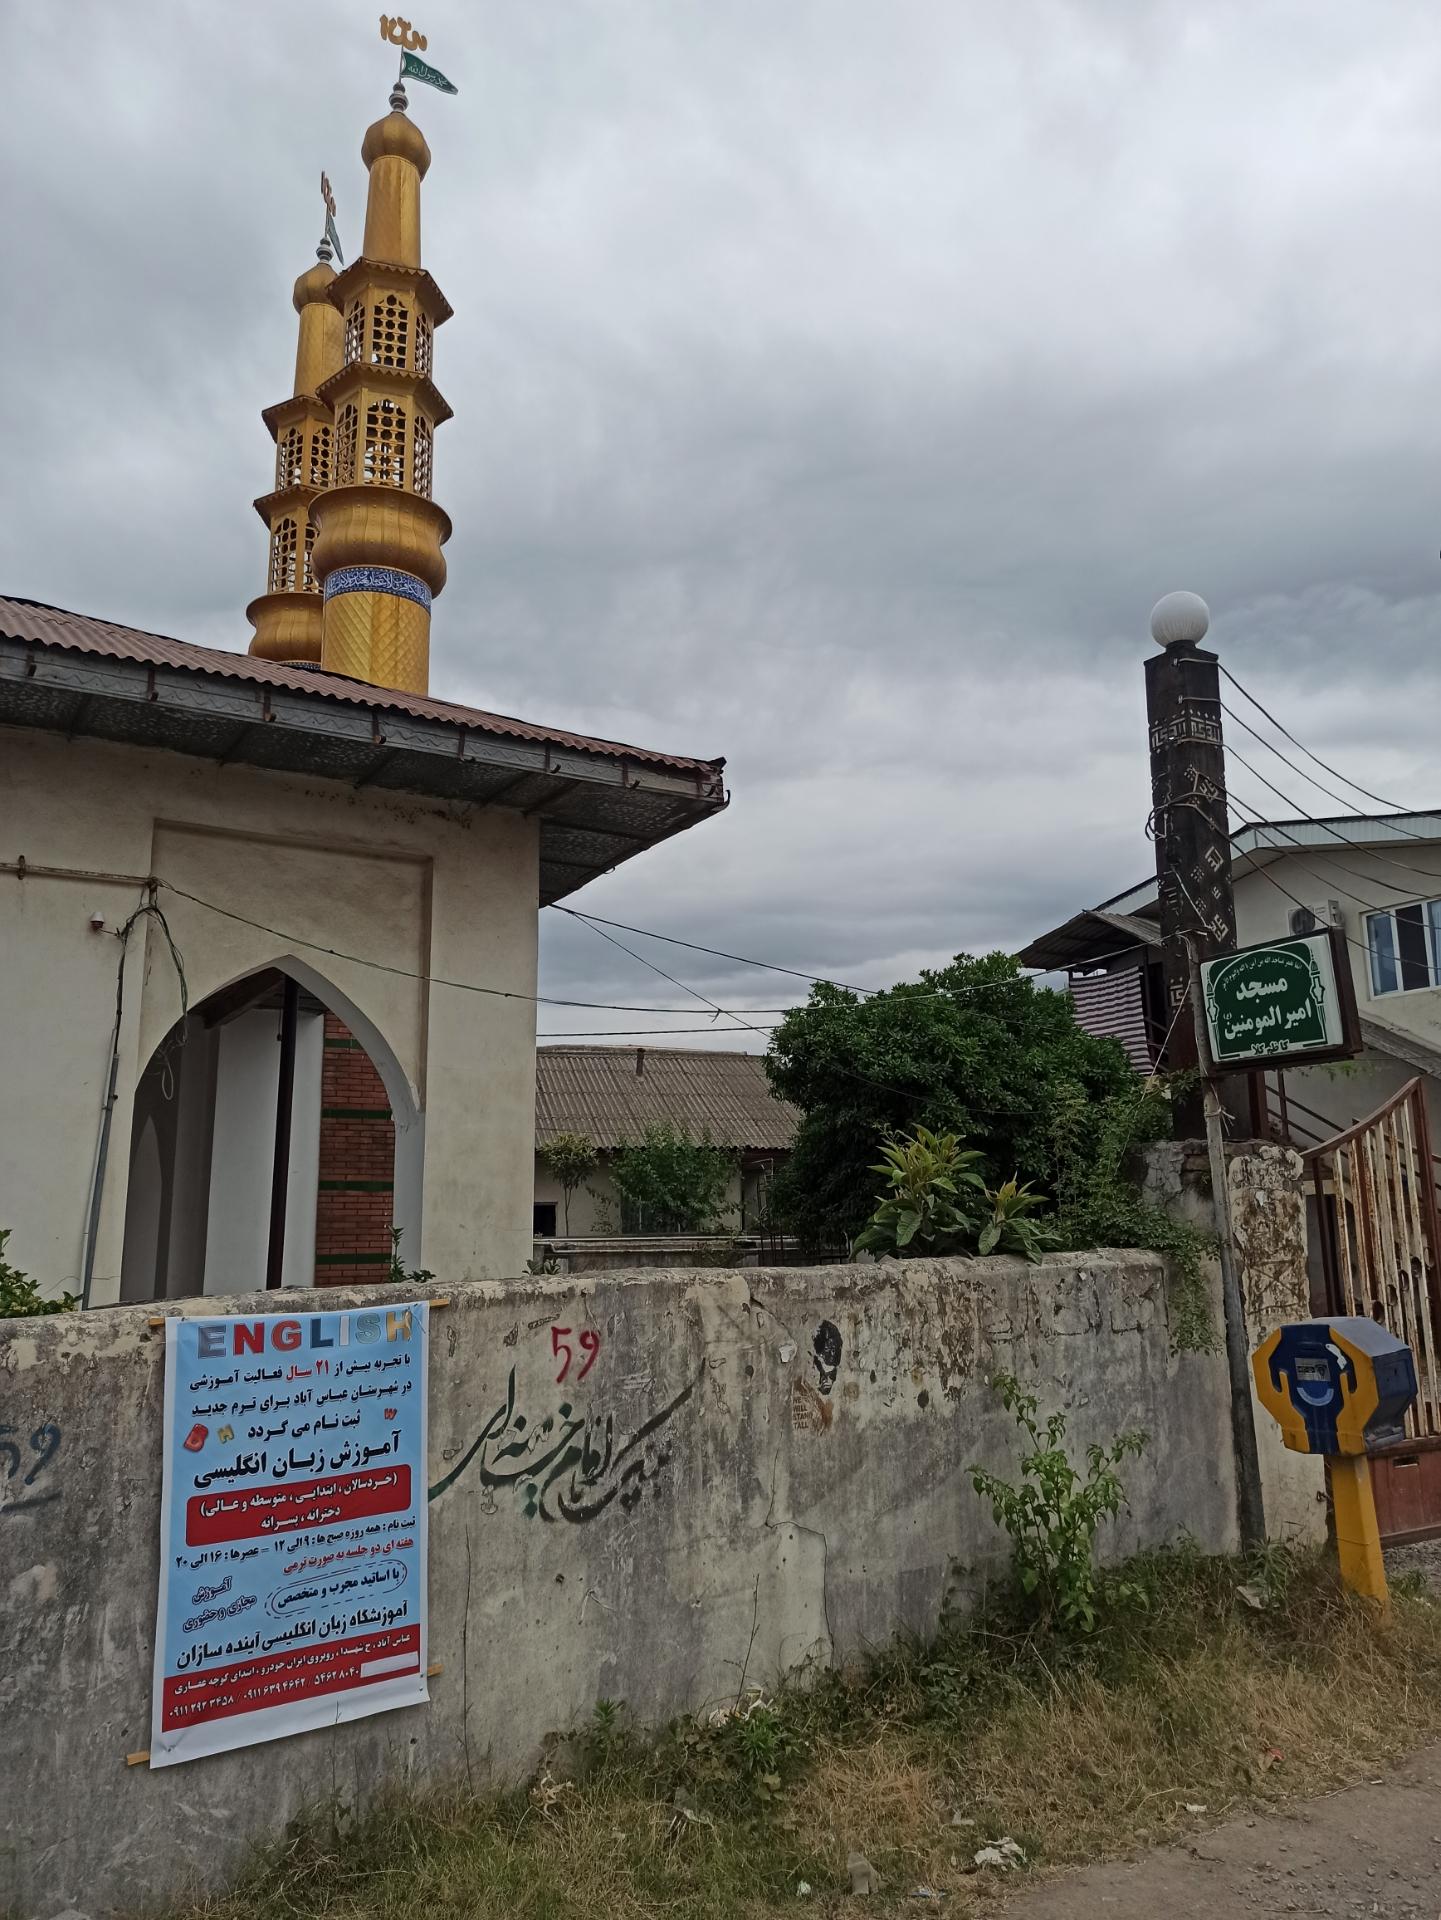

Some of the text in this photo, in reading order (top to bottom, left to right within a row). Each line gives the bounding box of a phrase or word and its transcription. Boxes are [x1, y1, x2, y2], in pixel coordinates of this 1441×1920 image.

[1236, 977, 1288, 1003] مسجد
[198, 1311, 412, 1359] ENGLISH
[551, 1326, 602, 1384] 59
[190, 1353, 411, 1390] با تجربه بیش از ۲۱ سال فعالیت آموزشی
[192, 1380, 412, 1416] در شهرستان عباس آباد برای ترم جدید
[247, 1409, 360, 1441] ثبت نام می گردد
[194, 1429, 402, 1489] آموزش زبان انگلیسی
[241, 1500, 248, 1512] و
[250, 1493, 287, 1508] متوسطه
[261, 1514, 299, 1530] پسرانه
[365, 1524, 380, 1534] همه
[401, 1516, 416, 1528] ثبت
[287, 1537, 302, 1552] الی
[370, 1544, 381, 1555] دو
[383, 1540, 394, 1555] ای
[396, 1537, 413, 1547] هفته
[336, 1551, 344, 1560] به
[346, 1545, 368, 1557] جلسه
[190, 1553, 208, 1569] الی
[192, 1576, 232, 1605] آموزش
[278, 1567, 400, 1608] با اساتید مجرب و متخصص
[183, 1595, 257, 1633] مجازی و حضوری
[177, 1600, 408, 1669] آموزشگاه زبان انگلیسی آینده سازان
